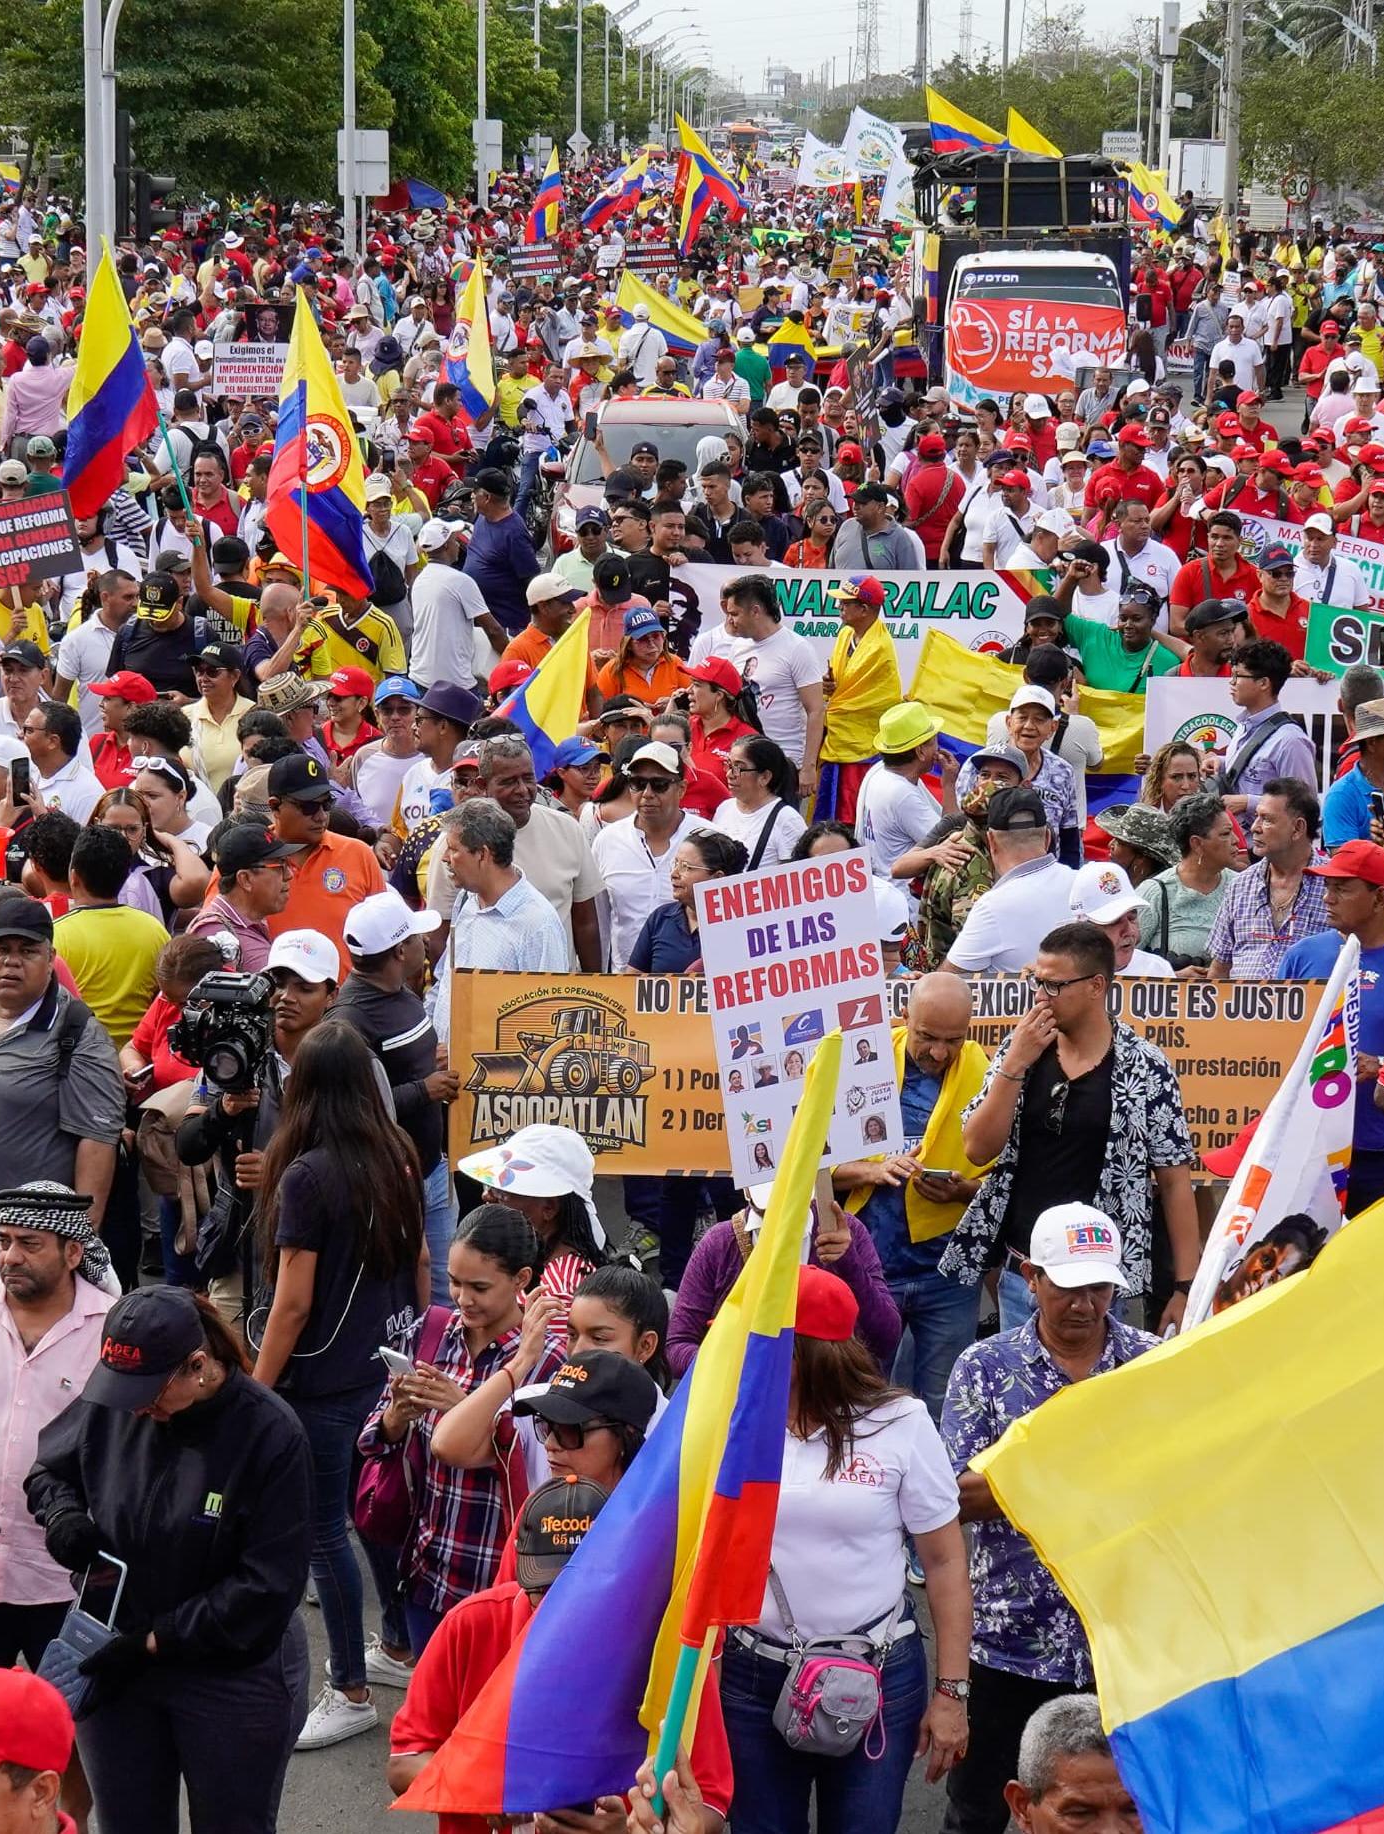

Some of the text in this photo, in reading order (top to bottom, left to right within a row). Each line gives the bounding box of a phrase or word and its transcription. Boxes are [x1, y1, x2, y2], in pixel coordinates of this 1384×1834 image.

[977, 274, 1019, 283] FOTON
[1007, 305, 1079, 330] SÍ A LA
[230, 345, 275, 355] Exigimos el
[1005, 327, 1125, 352] REFORMA
[219, 363, 284, 374] IMPLEMENTACIÓN
[1004, 353, 1028, 362] A LA
[237, 385, 276, 394] MAGISTERIO
[14, 507, 68, 532] REFORMA
[15, 524, 71, 547] GENERAL
[771, 578, 1000, 621] NALRALAC
[793, 621, 919, 640] BARRILLA
[704, 858, 868, 925] ENEMIGOS
[746, 911, 837, 959] DE LAS
[712, 942, 880, 1011] REFORMAS
[551, 986, 563, 995] DE
[636, 978, 671, 1014] NO
[1130, 986, 1180, 1021] QUE
[1186, 987, 1216, 1020] ES
[1226, 988, 1305, 1022] JUSTO
[1144, 1021, 1192, 1049] PAÍS.
[662, 1068, 672, 1091] 1
[1175, 1055, 1282, 1084] prestación
[661, 1108, 674, 1131] 2
[1226, 1110, 1236, 1125] a
[1066, 1226, 1113, 1246] PETRO
[837, 1470, 877, 1486] ADEA
[552, 1533, 568, 1546] 65
